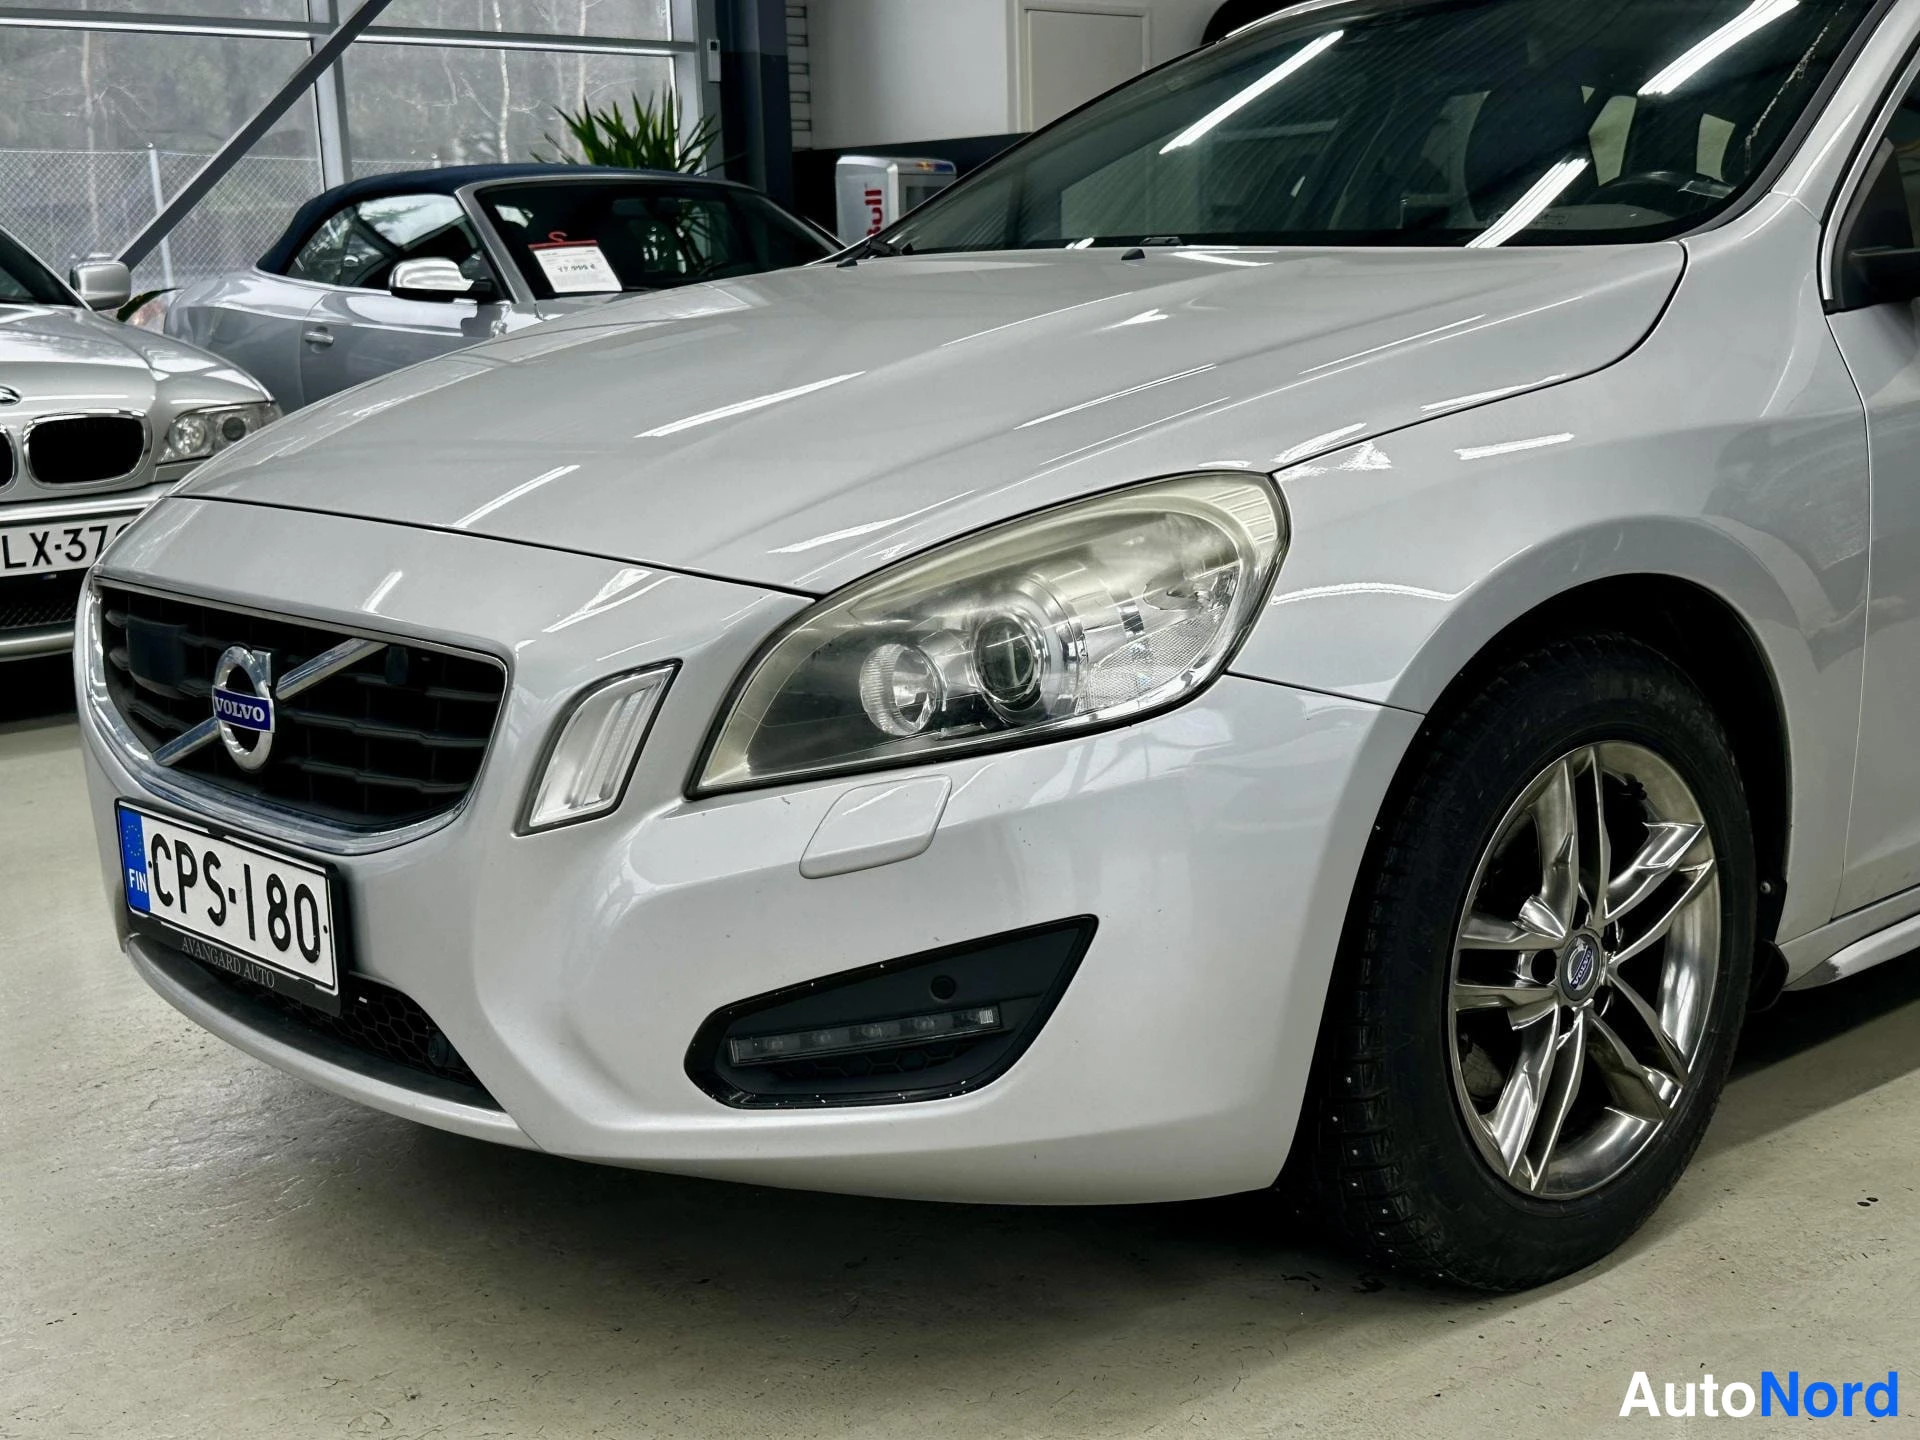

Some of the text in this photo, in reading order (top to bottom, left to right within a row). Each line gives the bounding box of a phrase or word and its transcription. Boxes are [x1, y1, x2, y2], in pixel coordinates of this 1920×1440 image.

[1, 523, 130, 570] LX-37
[214, 696, 266, 722] VOLVO
[128, 867, 148, 895] FIN
[150, 833, 321, 964] CPS-180
[181, 936, 276, 989] AVANGARD AUTO
